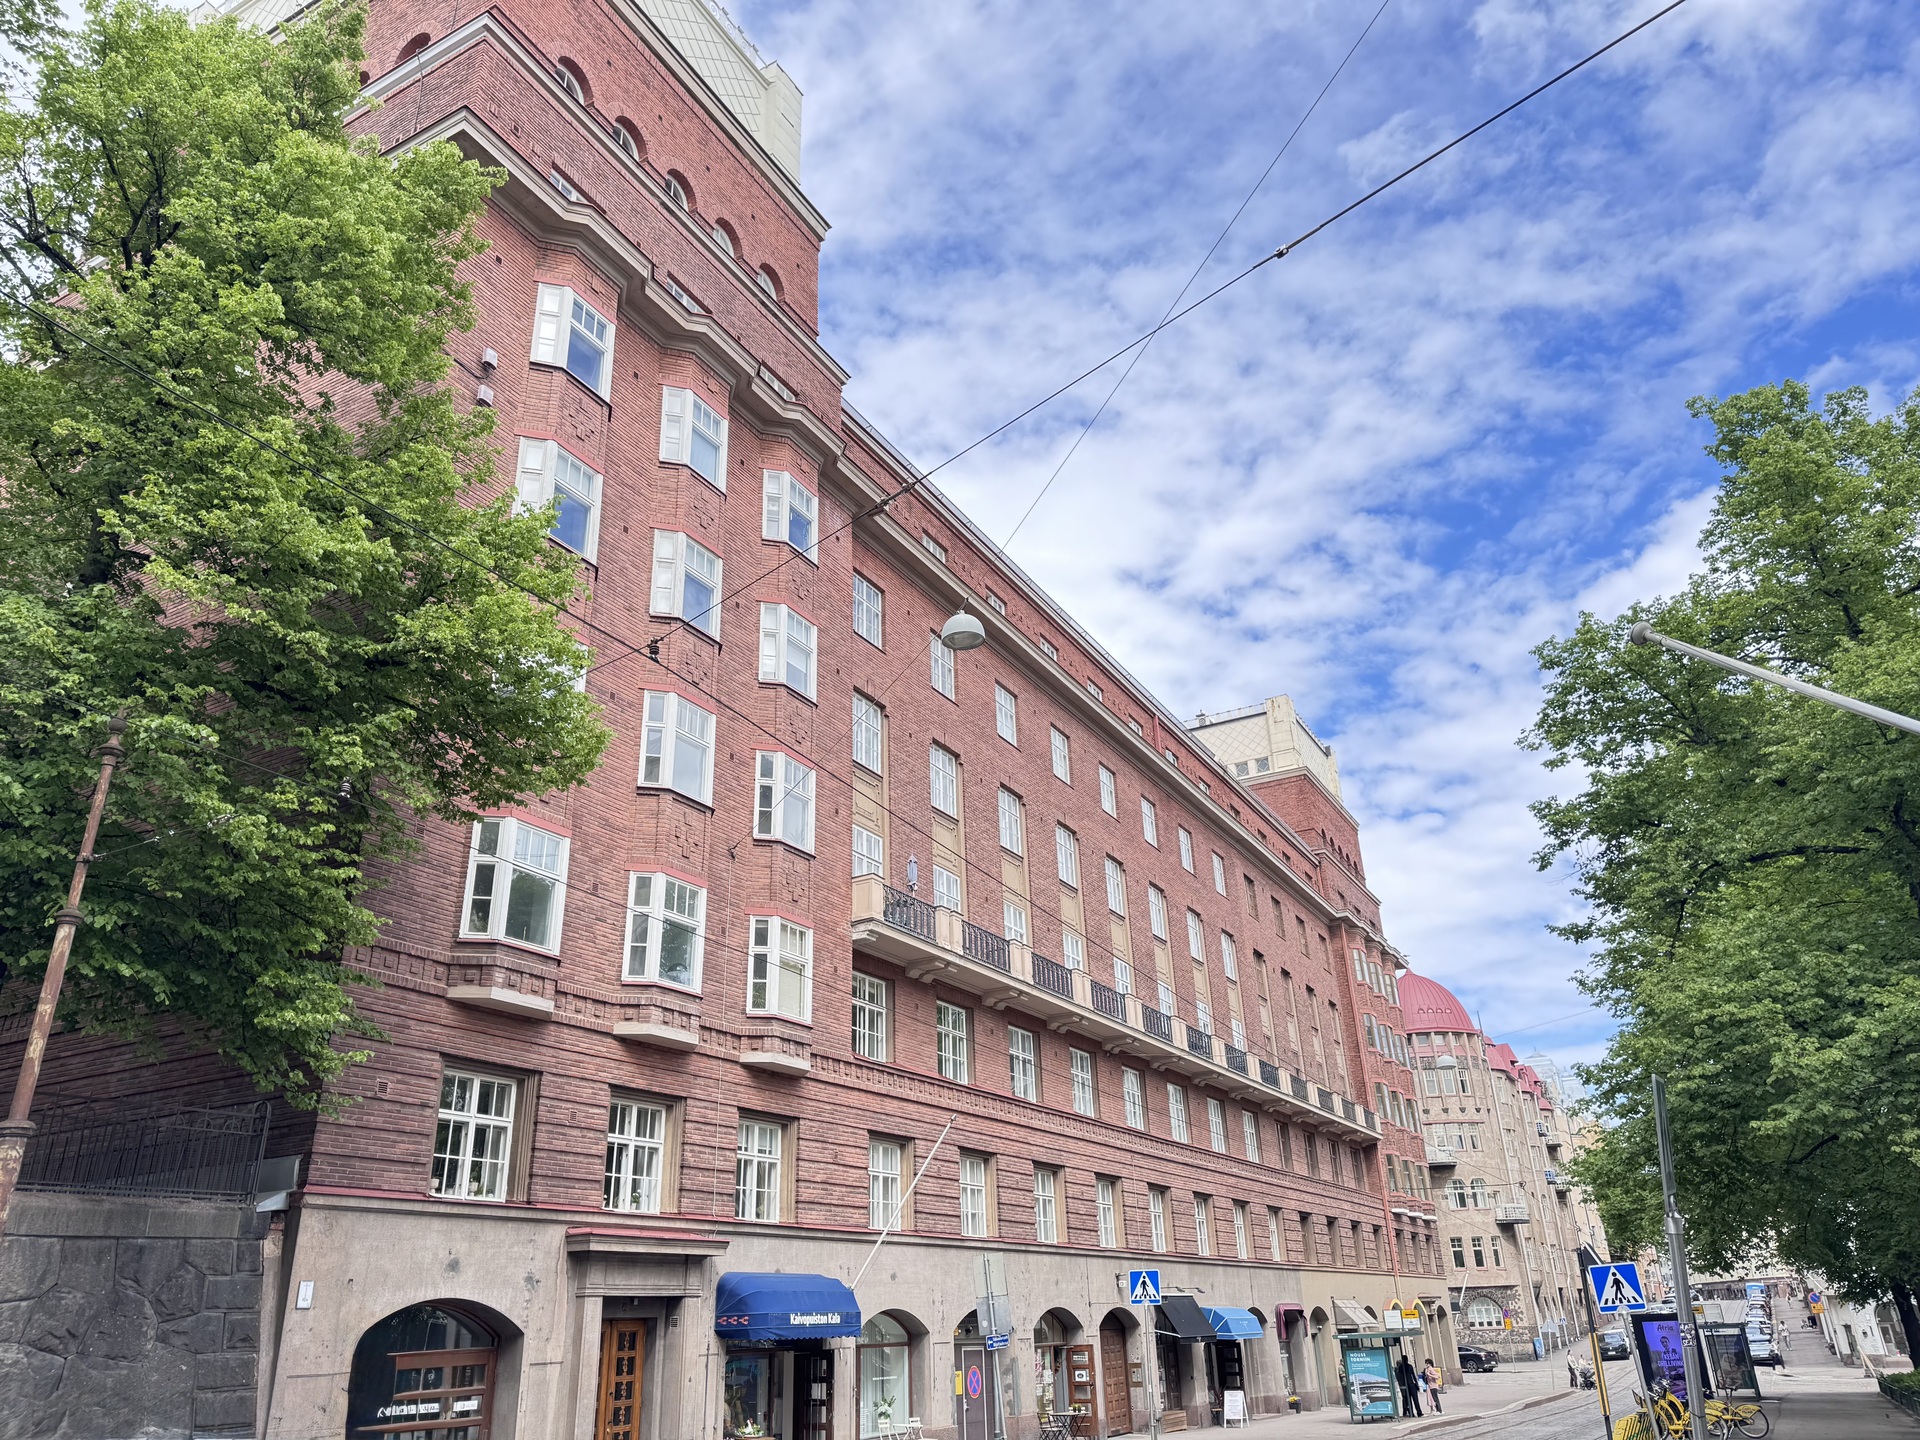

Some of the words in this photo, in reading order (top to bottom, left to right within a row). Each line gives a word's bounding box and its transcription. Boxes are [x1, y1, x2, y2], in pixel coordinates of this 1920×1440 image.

[790, 1312, 827, 1327] Kaivopuiston
[828, 1312, 841, 1324] Kala
[1657, 1323, 1674, 1332] Atria
